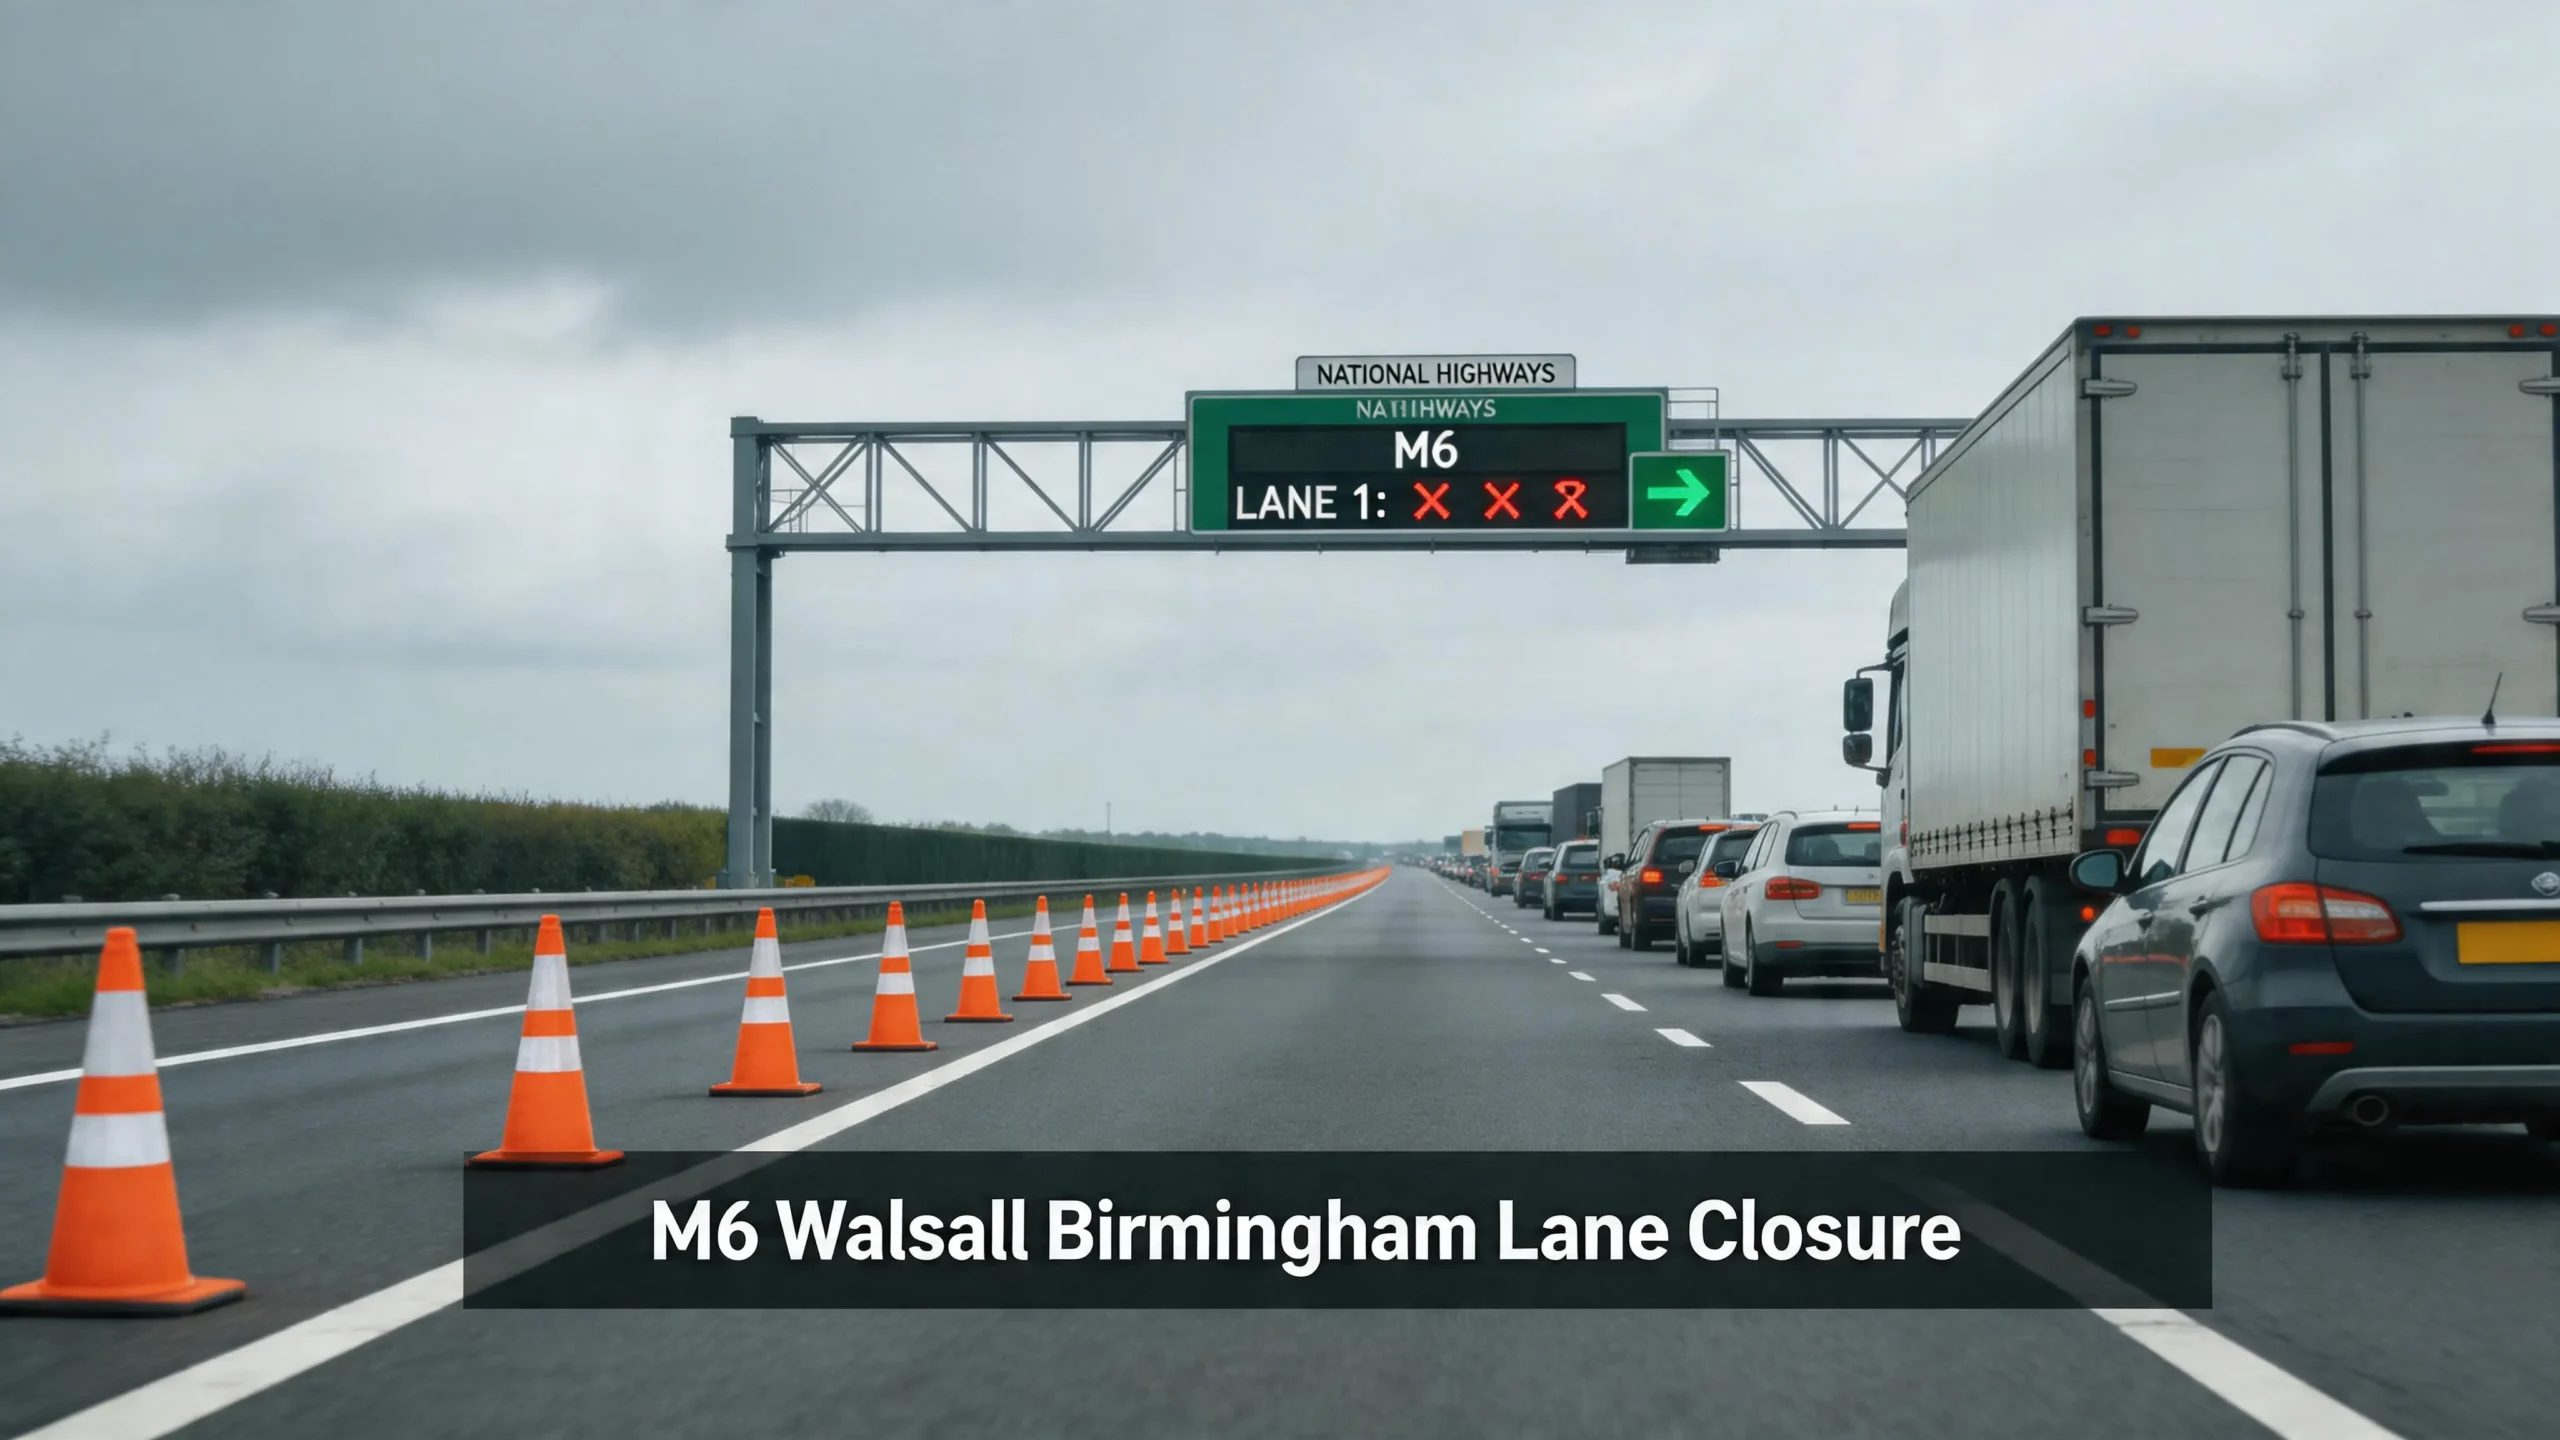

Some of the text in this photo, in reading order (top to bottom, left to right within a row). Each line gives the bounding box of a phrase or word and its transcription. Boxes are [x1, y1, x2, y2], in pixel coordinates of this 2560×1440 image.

[1317, 362, 1556, 386] NATIONAL HIGHWAYS
[1395, 429, 1459, 469] M6
[1236, 484, 1337, 520] LANE
[1353, 483, 1387, 520] 1:
